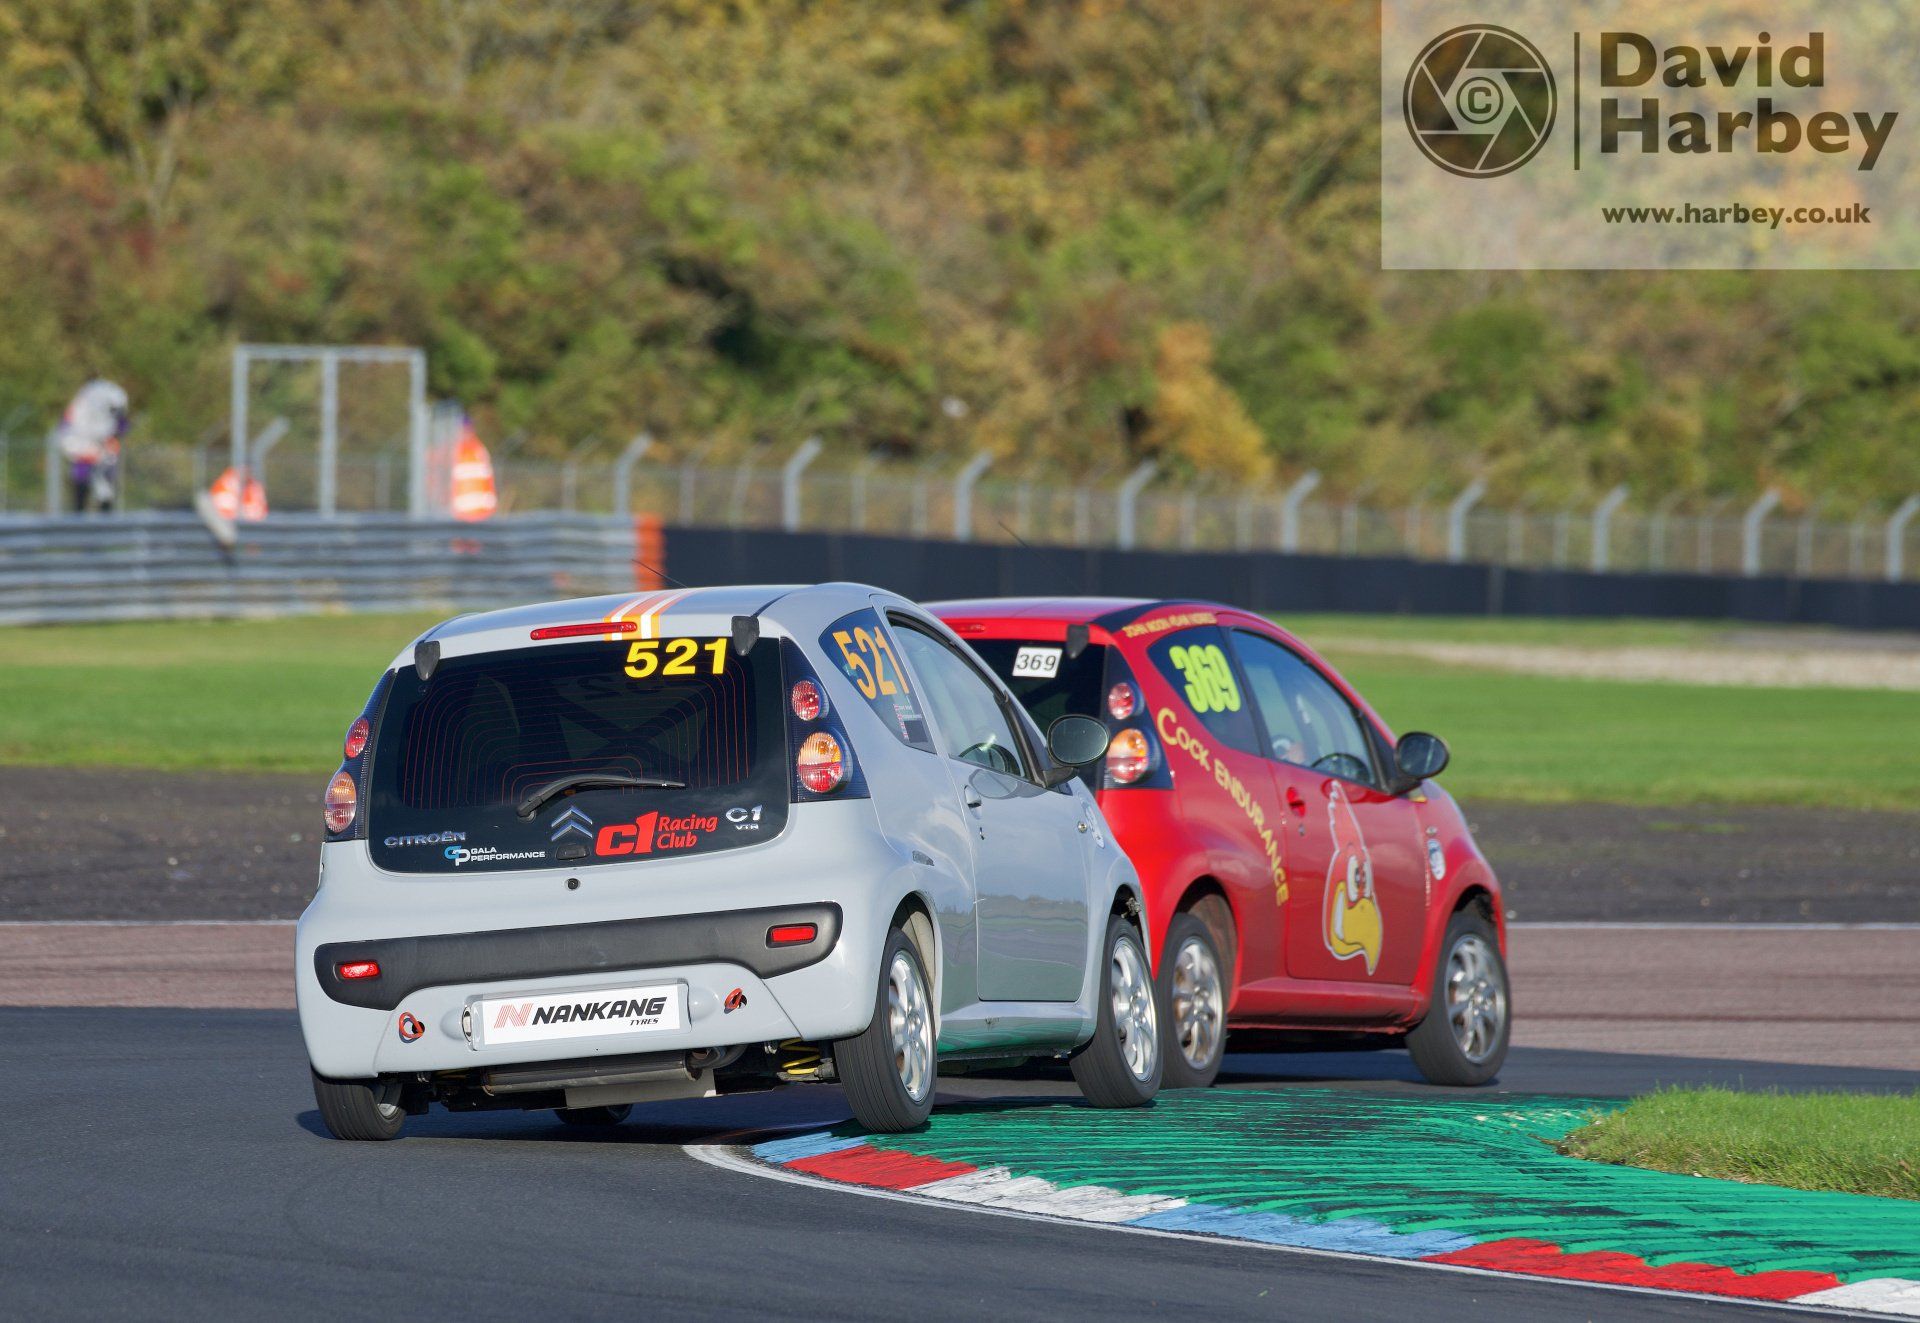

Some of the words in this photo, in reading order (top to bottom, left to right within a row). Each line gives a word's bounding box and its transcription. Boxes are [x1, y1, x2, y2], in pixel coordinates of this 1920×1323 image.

[624, 638, 728, 678] 521
[832, 626, 910, 700] 521
[1016, 654, 1057, 671] 369
[1169, 644, 1242, 713] 369
[725, 804, 763, 822] C1
[658, 813, 719, 833] Racing
[1214, 757, 1290, 907] ENDURANCE
[383, 831, 466, 847] CITROËN
[596, 811, 659, 856] C1
[656, 831, 698, 849] Club
[471, 846, 497, 855] GALA
[471, 851, 546, 862] PERFORMANCE
[531, 996, 668, 1026] NANKANG
[629, 1017, 659, 1027] TYRES
